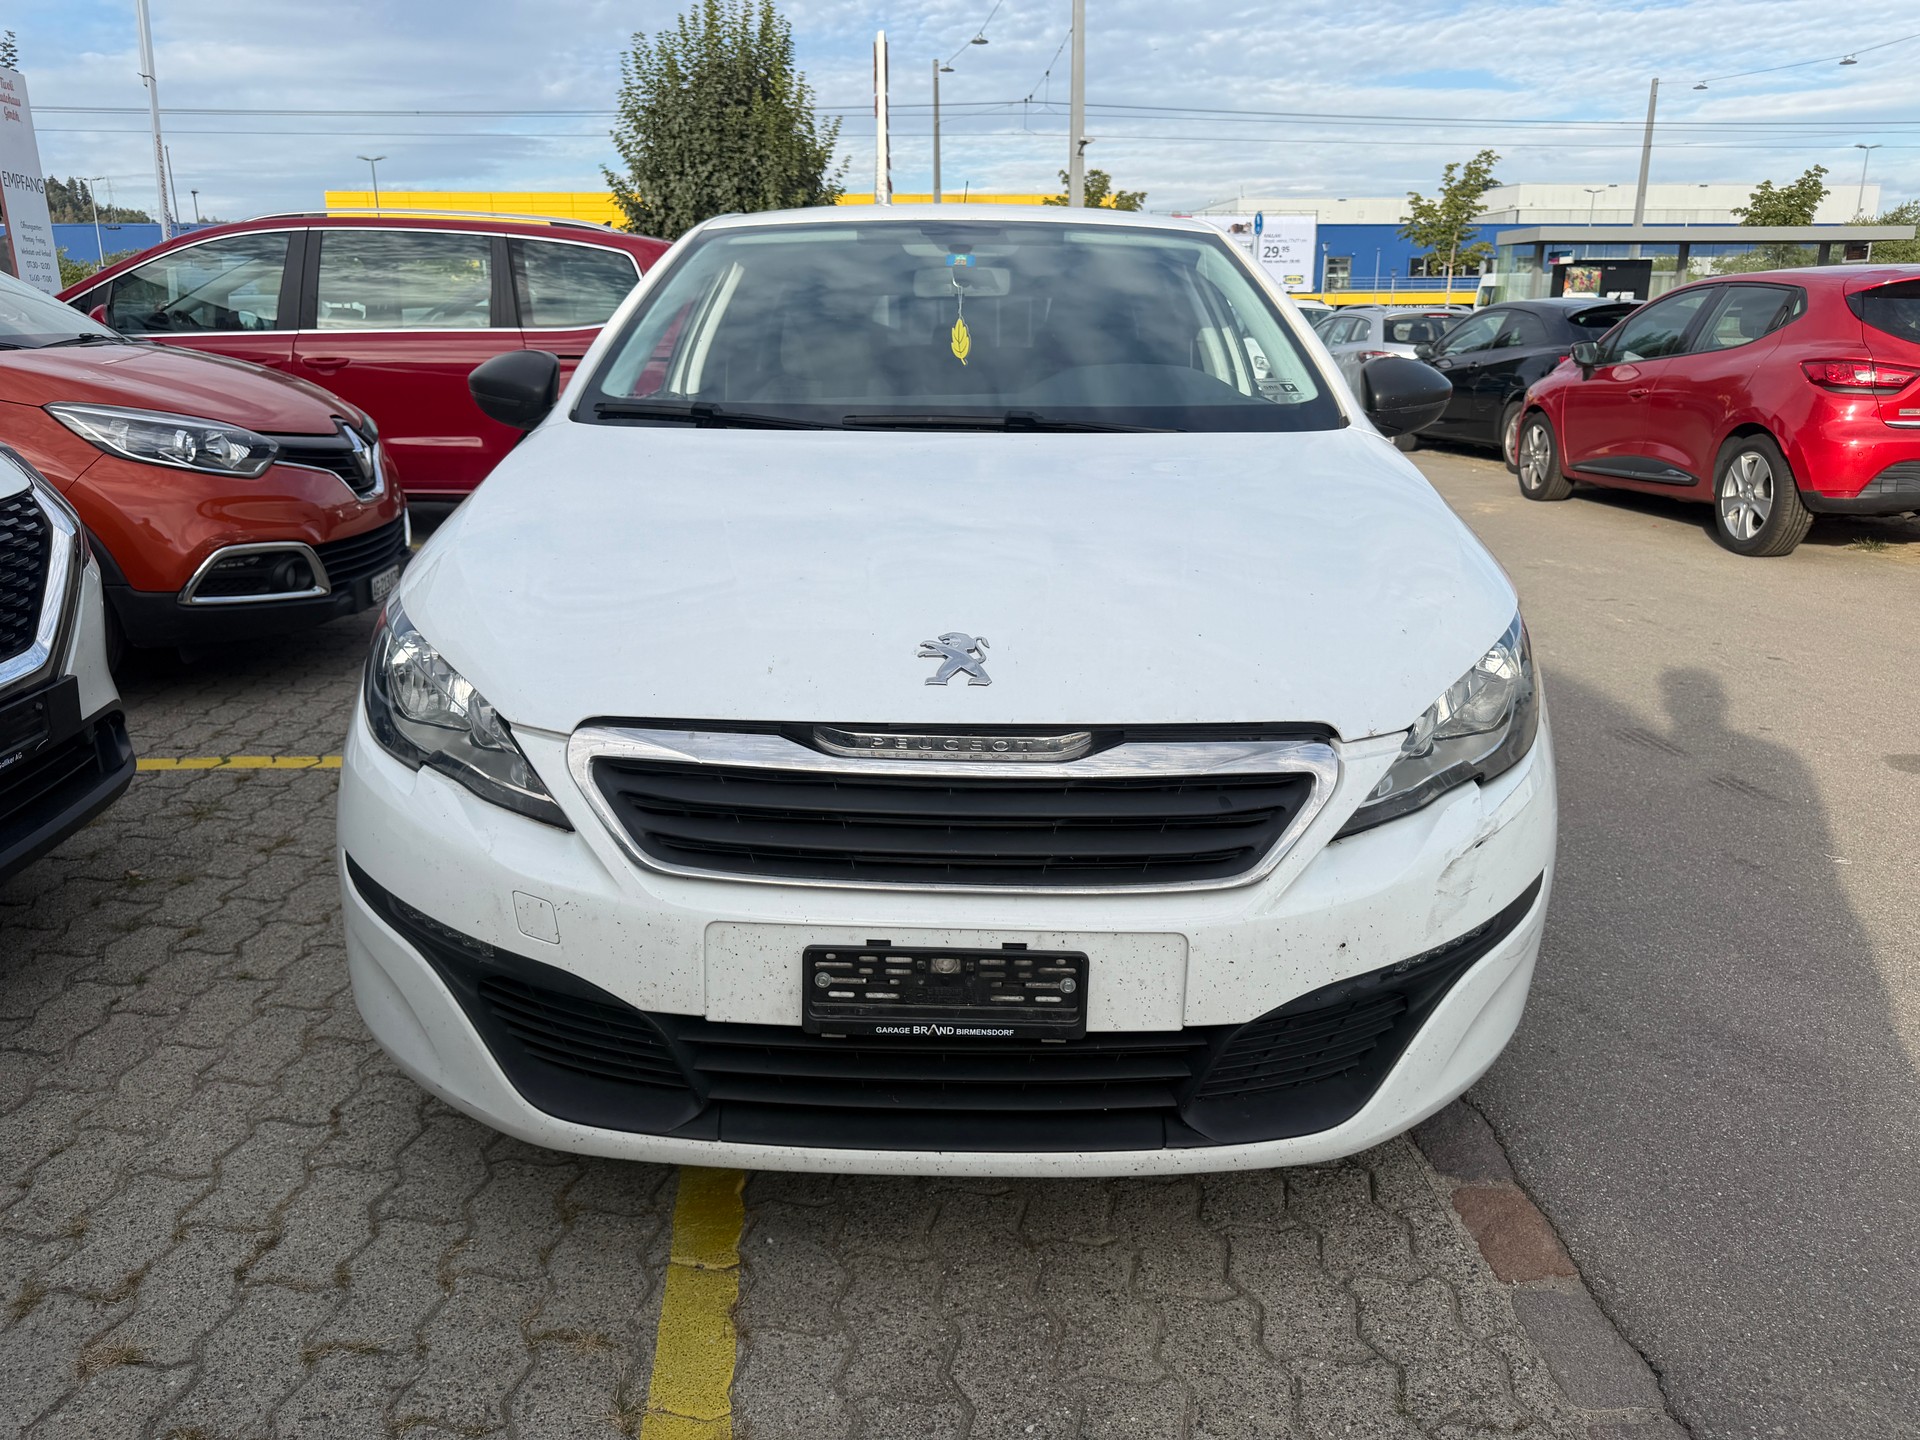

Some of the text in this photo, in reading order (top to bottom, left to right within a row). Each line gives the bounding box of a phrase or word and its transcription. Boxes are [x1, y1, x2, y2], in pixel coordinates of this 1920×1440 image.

[2, 170, 44, 194] EMPFANG
[869, 737, 1033, 752] PEUGEOT
[15, 751, 23, 761] AG
[875, 1023, 1015, 1036] GARAGE BRAND BIRMENSDORF
